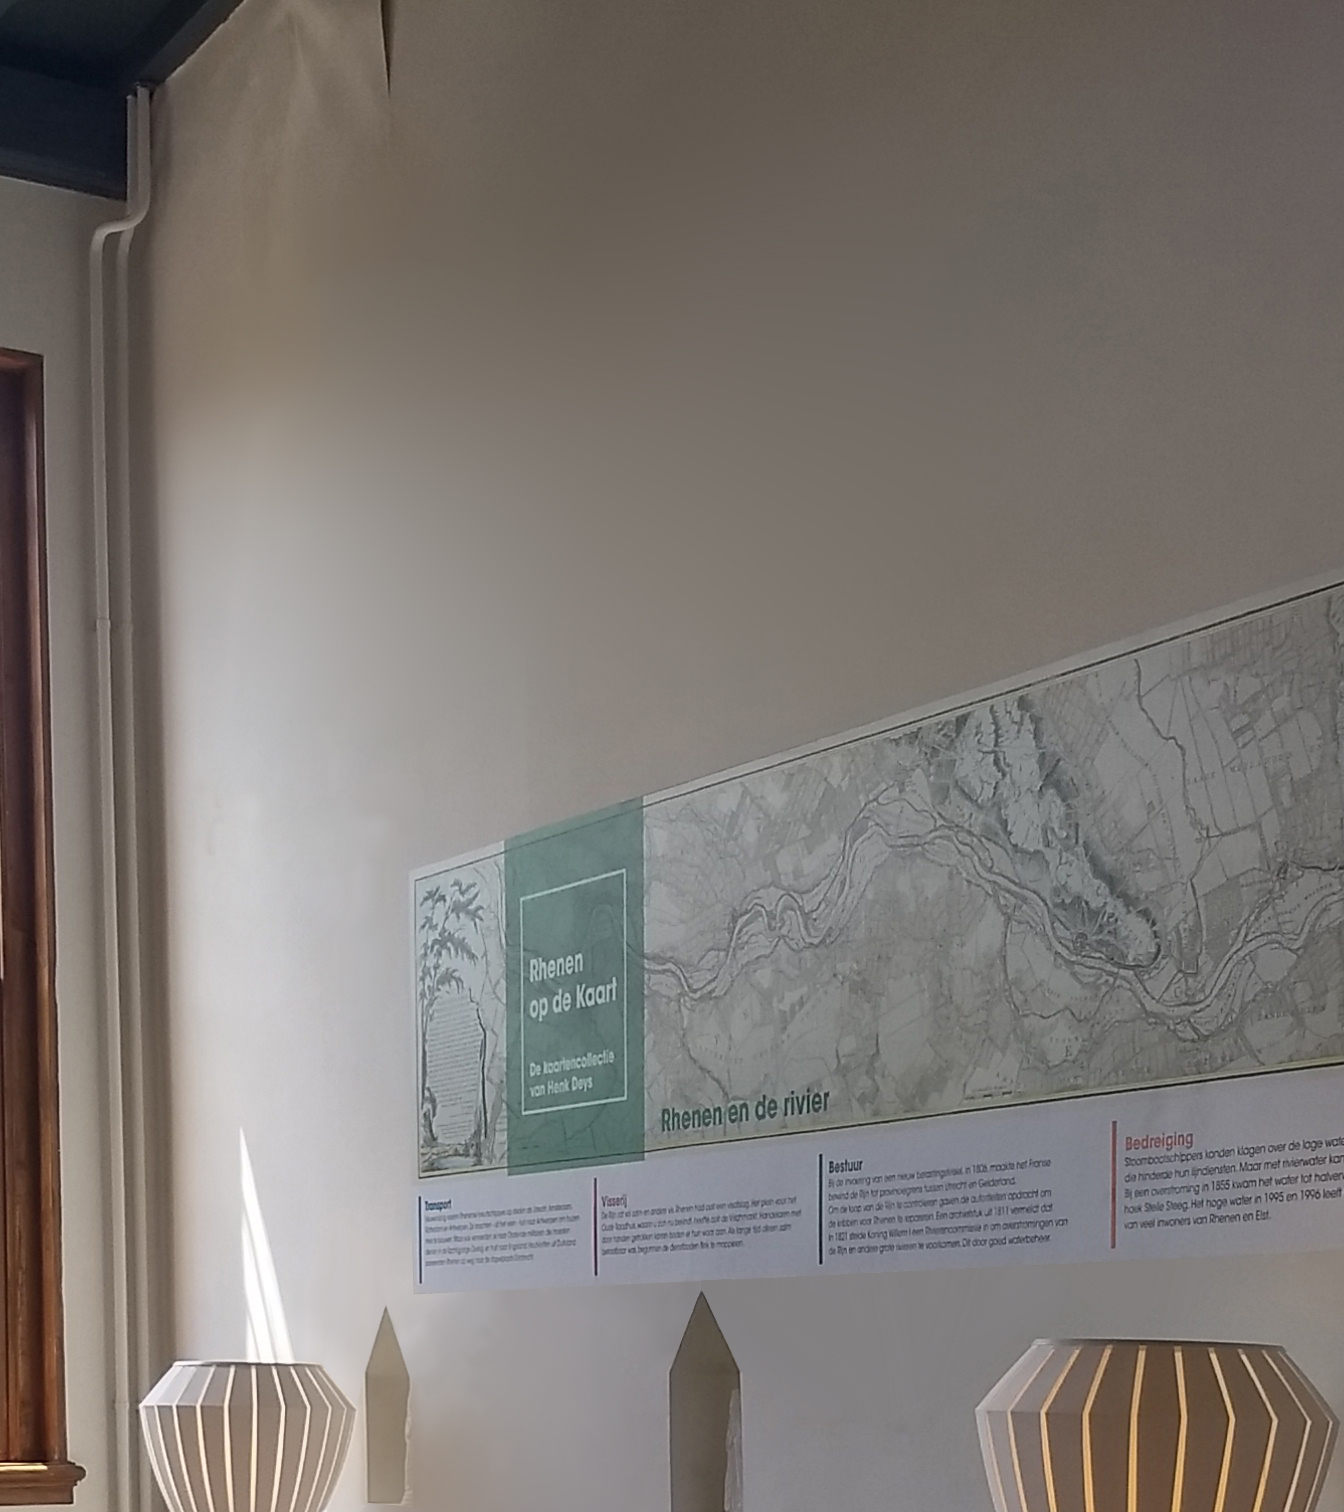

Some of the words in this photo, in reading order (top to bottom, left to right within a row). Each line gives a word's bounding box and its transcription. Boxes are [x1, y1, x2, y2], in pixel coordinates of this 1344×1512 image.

[530, 952, 583, 982] Rhenen
[530, 1000, 548, 1020] op
[553, 990, 571, 1012] de
[576, 977, 617, 1008] Kaart
[530, 1062, 541, 1077] De
[543, 1050, 614, 1074] kaartencollectie
[530, 1084, 546, 1097] van
[548, 1077, 569, 1094] Henk
[661, 1104, 722, 1132] Rhenen
[728, 1102, 749, 1123] en
[756, 1095, 778, 1120] de
[784, 1088, 830, 1116] rivier
[1125, 1132, 1193, 1151] Bedreiging
[1267, 1144, 1286, 1153] over
[1287, 1140, 1301, 1151] de
[828, 1159, 863, 1173] Bestuur
[1124, 1172, 1136, 1183] die
[1174, 1168, 1190, 1178] hun
[1239, 1161, 1262, 1172] Maar
[1263, 1159, 1281, 1170] met
[1282, 1155, 1327, 1168] rivierwater
[1134, 1189, 1149, 1197] een
[1201, 1182, 1209, 1192] in
[1231, 1178, 1257, 1189] kwam
[1258, 1176, 1273, 1187] het
[1274, 1174, 1299, 1186] water
[1300, 1173, 1312, 1184] tot
[1190, 1198, 1204, 1208] Het
[1205, 1197, 1228, 1210] hoge
[1229, 1195, 1252, 1206] water
[1254, 1195, 1262, 1204] in
[1264, 1192, 1284, 1203] 1995
[1285, 1194, 1298, 1202] en
[1300, 1189, 1321, 1200] 1996
[1322, 1188, 1342, 1199] leeft
[1124, 1221, 1138, 1229] van
[1139, 1218, 1155, 1228] veel
[1192, 1217, 1208, 1225] van
[1209, 1213, 1241, 1223] Rhenen
[1242, 1214, 1254, 1222] en
